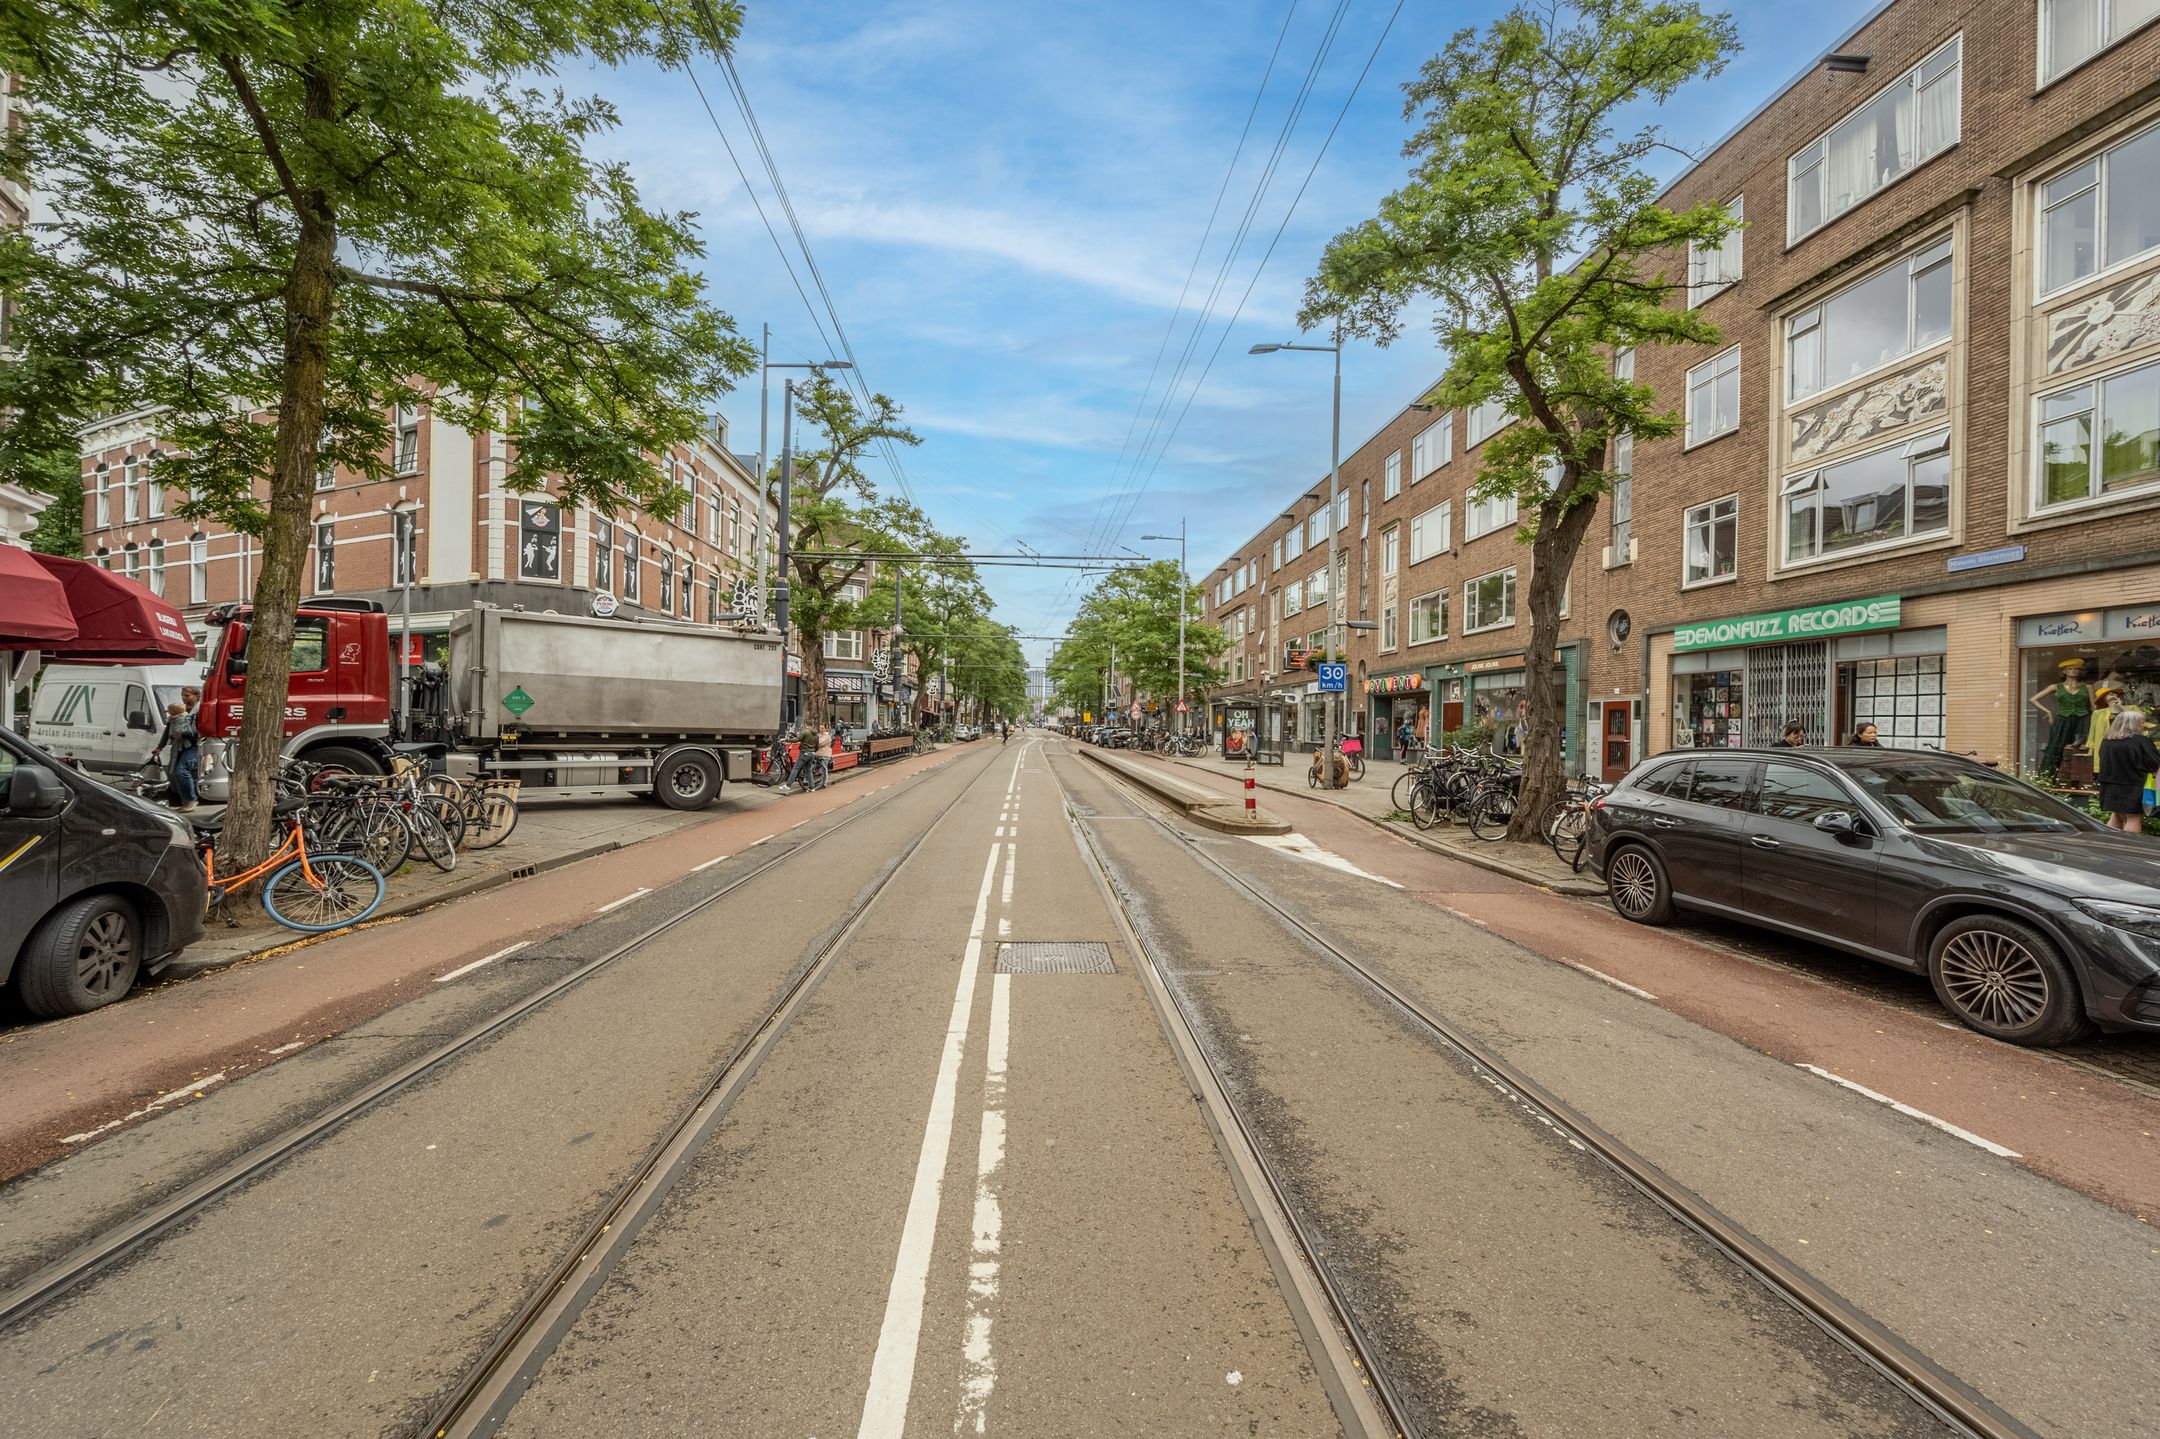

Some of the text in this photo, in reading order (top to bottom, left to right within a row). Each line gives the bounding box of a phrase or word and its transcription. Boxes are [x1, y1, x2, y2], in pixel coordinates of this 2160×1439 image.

[1680, 602, 1884, 647] DEMONFUZZ RECORDS
[1321, 666, 1344, 680] 30
[1321, 681, 1343, 689] km/h
[1233, 710, 1249, 719] OH
[1227, 718, 1255, 727] YEAH
[37, 727, 60, 737] Arslan
